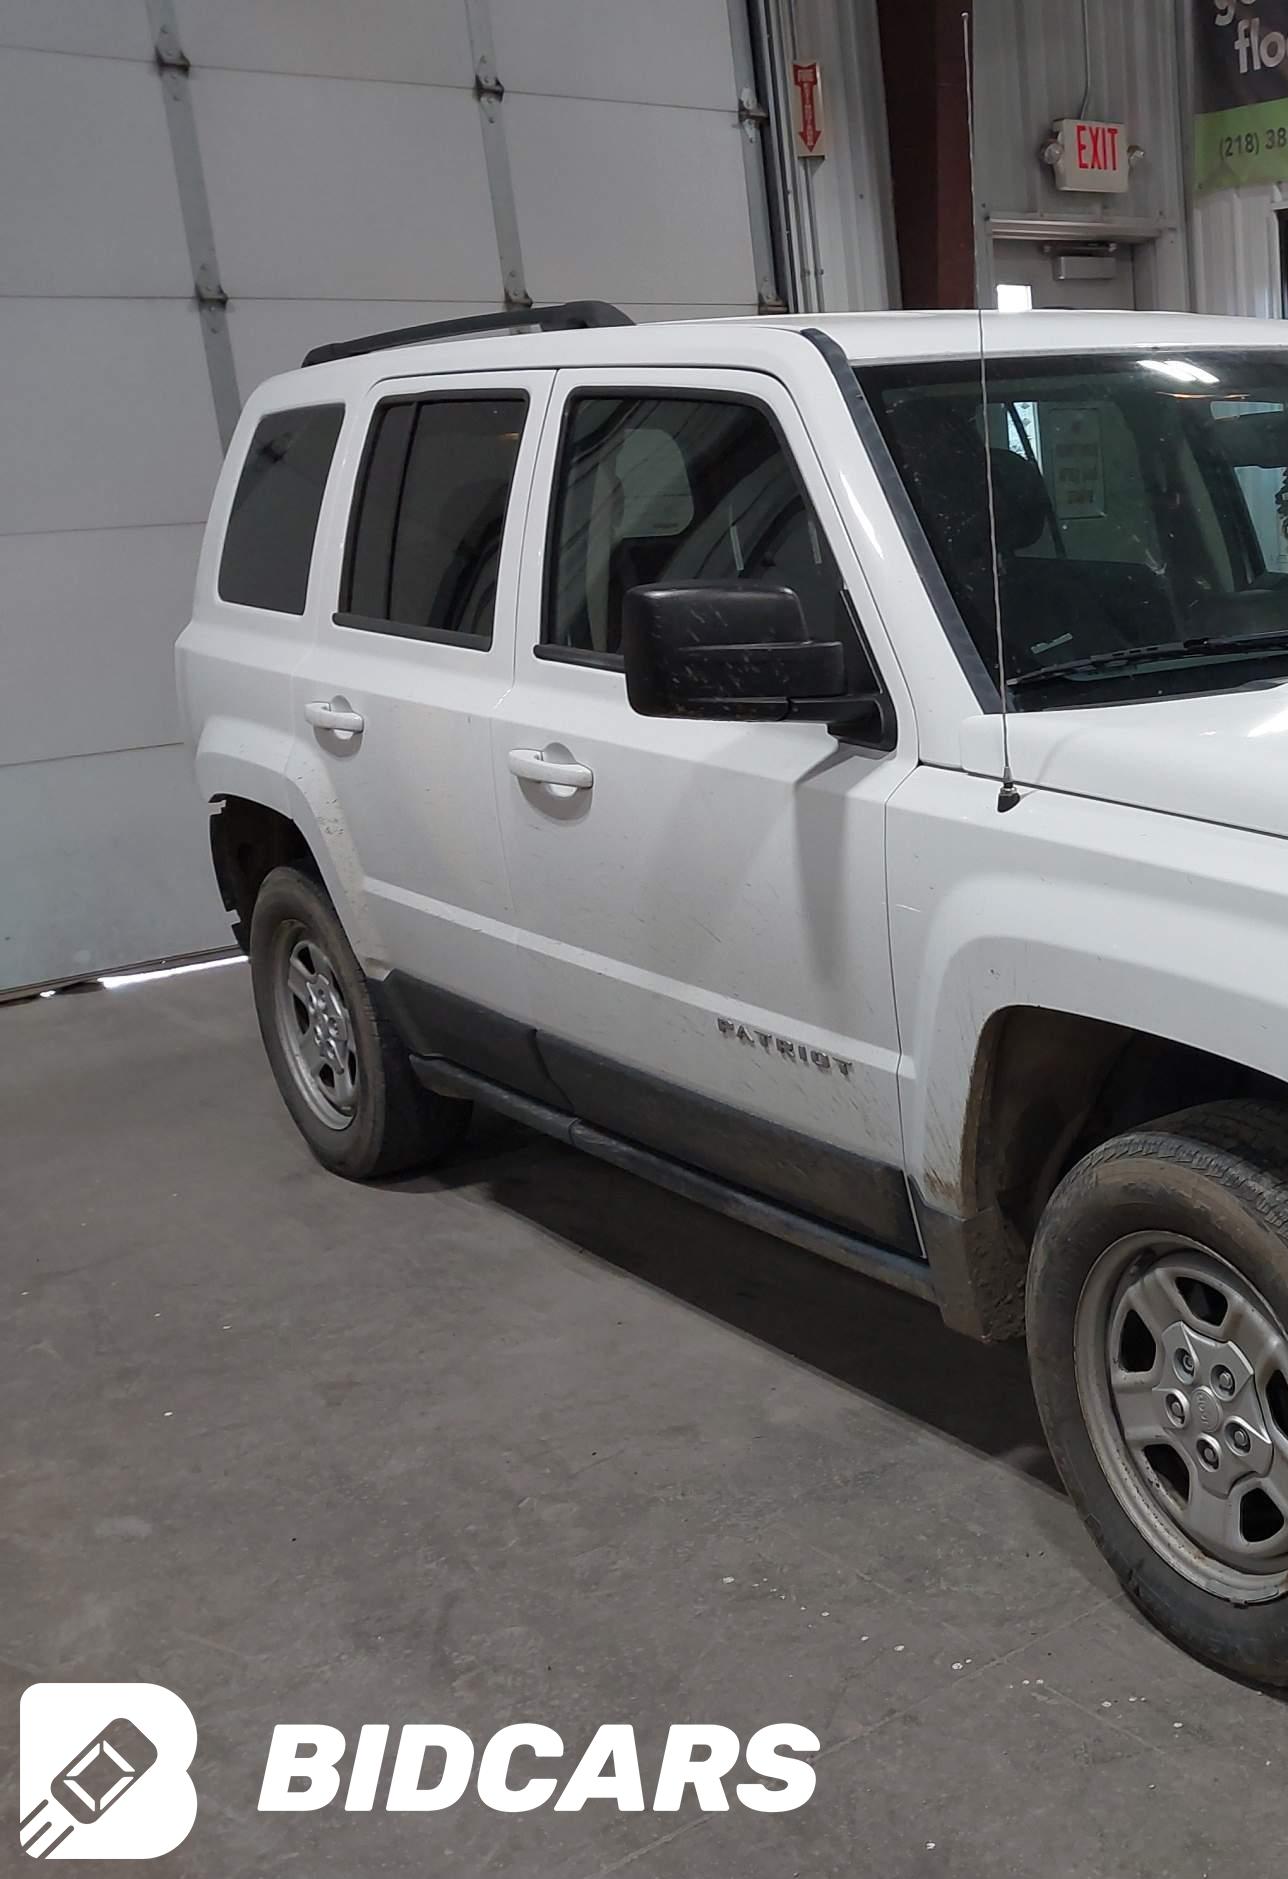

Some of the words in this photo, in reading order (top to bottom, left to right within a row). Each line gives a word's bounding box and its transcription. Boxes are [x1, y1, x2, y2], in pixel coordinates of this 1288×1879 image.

[1076, 124, 1118, 171] EXIT
[1219, 132, 1260, 160] (218)
[717, 1017, 853, 1077] PATRIOT
